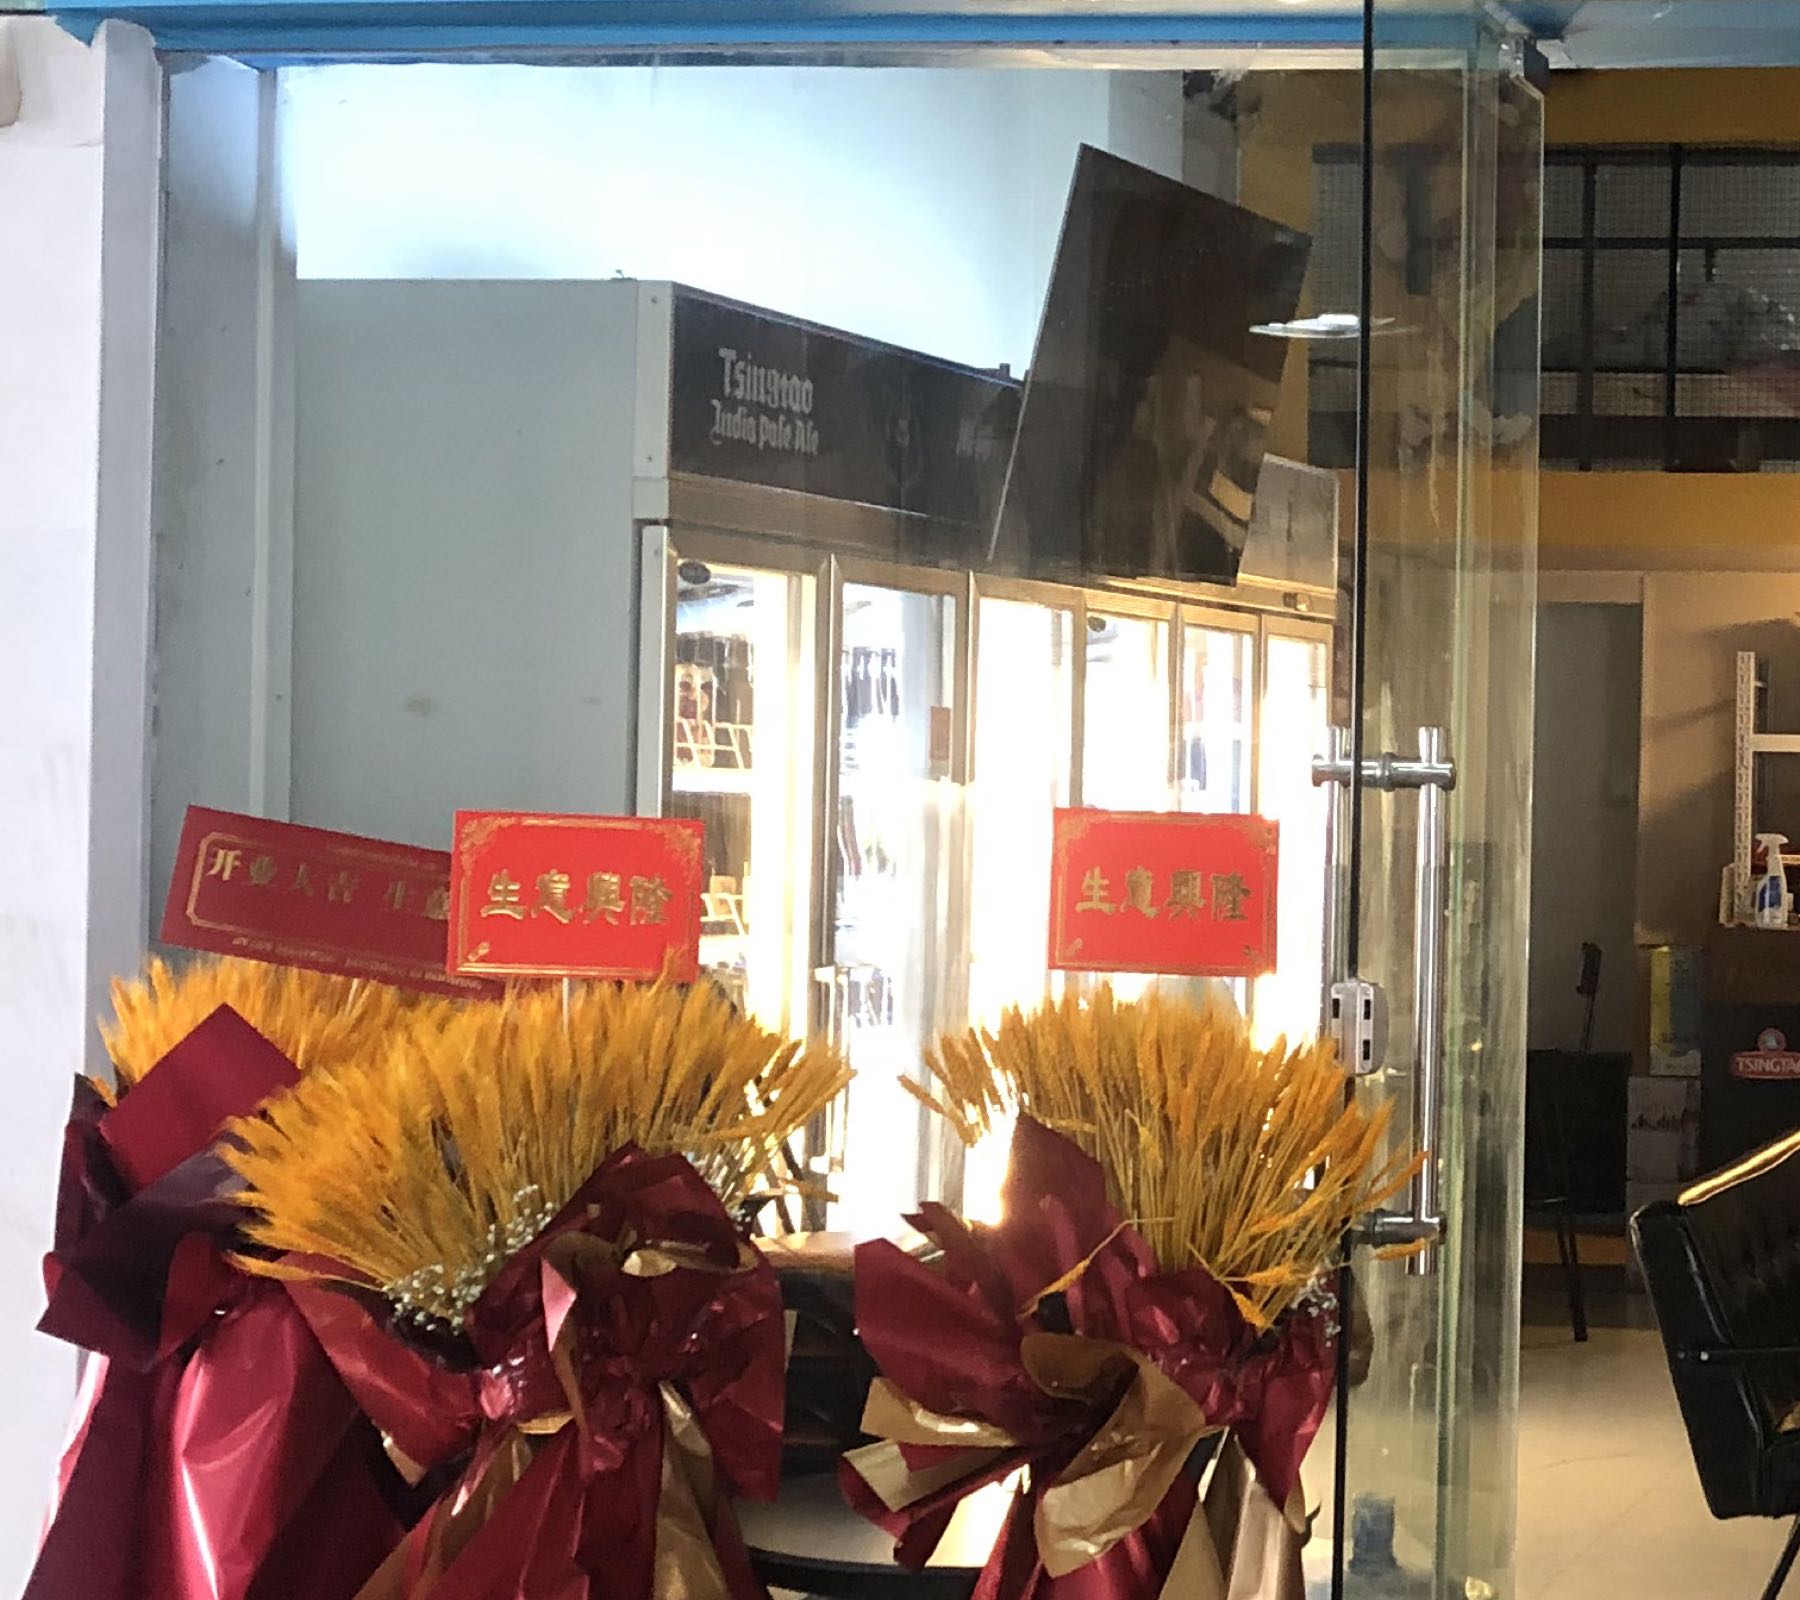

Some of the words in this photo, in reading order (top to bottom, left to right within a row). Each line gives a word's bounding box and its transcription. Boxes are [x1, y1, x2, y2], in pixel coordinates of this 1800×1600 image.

[480, 868, 673, 925] 生意興隆
[1075, 866, 1251, 921] 生意興隆
